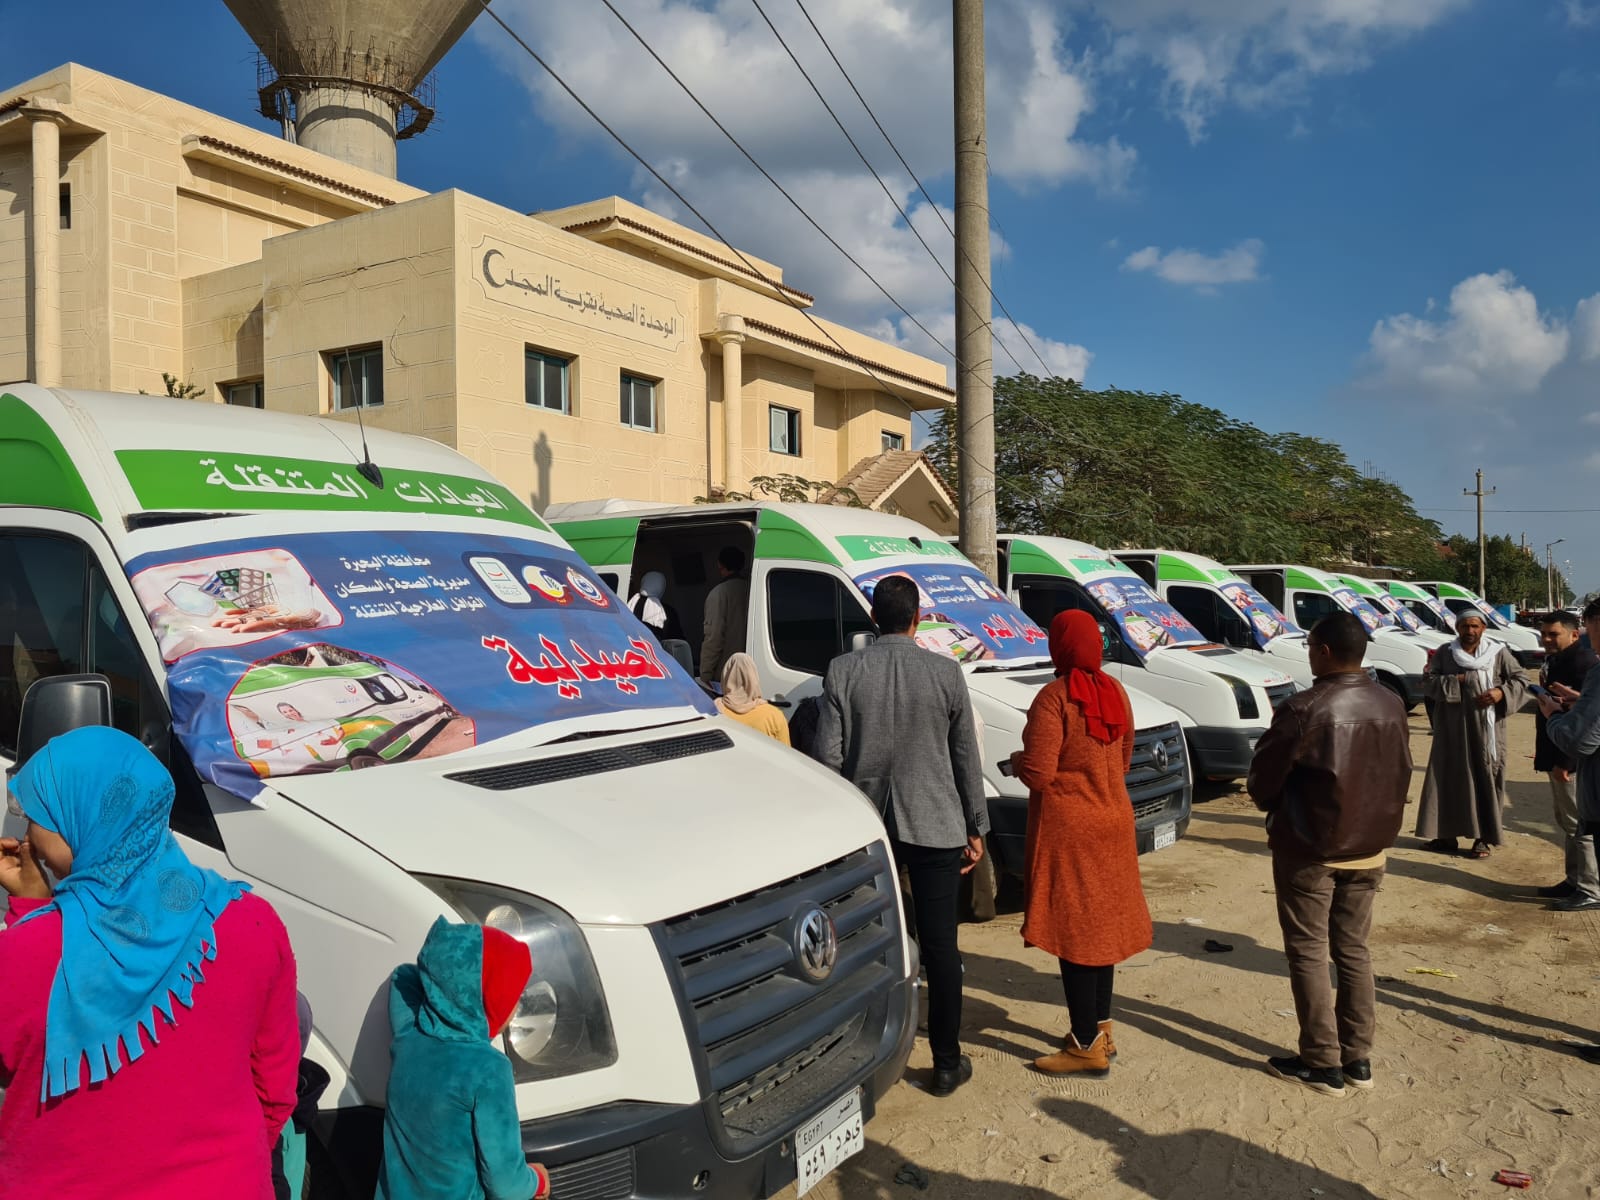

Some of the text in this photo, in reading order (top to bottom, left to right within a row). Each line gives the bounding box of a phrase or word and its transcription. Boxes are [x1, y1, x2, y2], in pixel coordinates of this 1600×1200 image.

[505, 268, 677, 338] الوحدة الصحية بقرية المجد
[199, 458, 510, 513] العيادات المتنقلة
[339, 554, 432, 573] محافظة البحيرة
[334, 575, 471, 598] مديرية الصحة والسكان
[350, 595, 487, 618] القوافل العلاجية المتنقلة
[481, 633, 673, 700] الصيدلية
[803, 1121, 824, 1145] EGYPT
